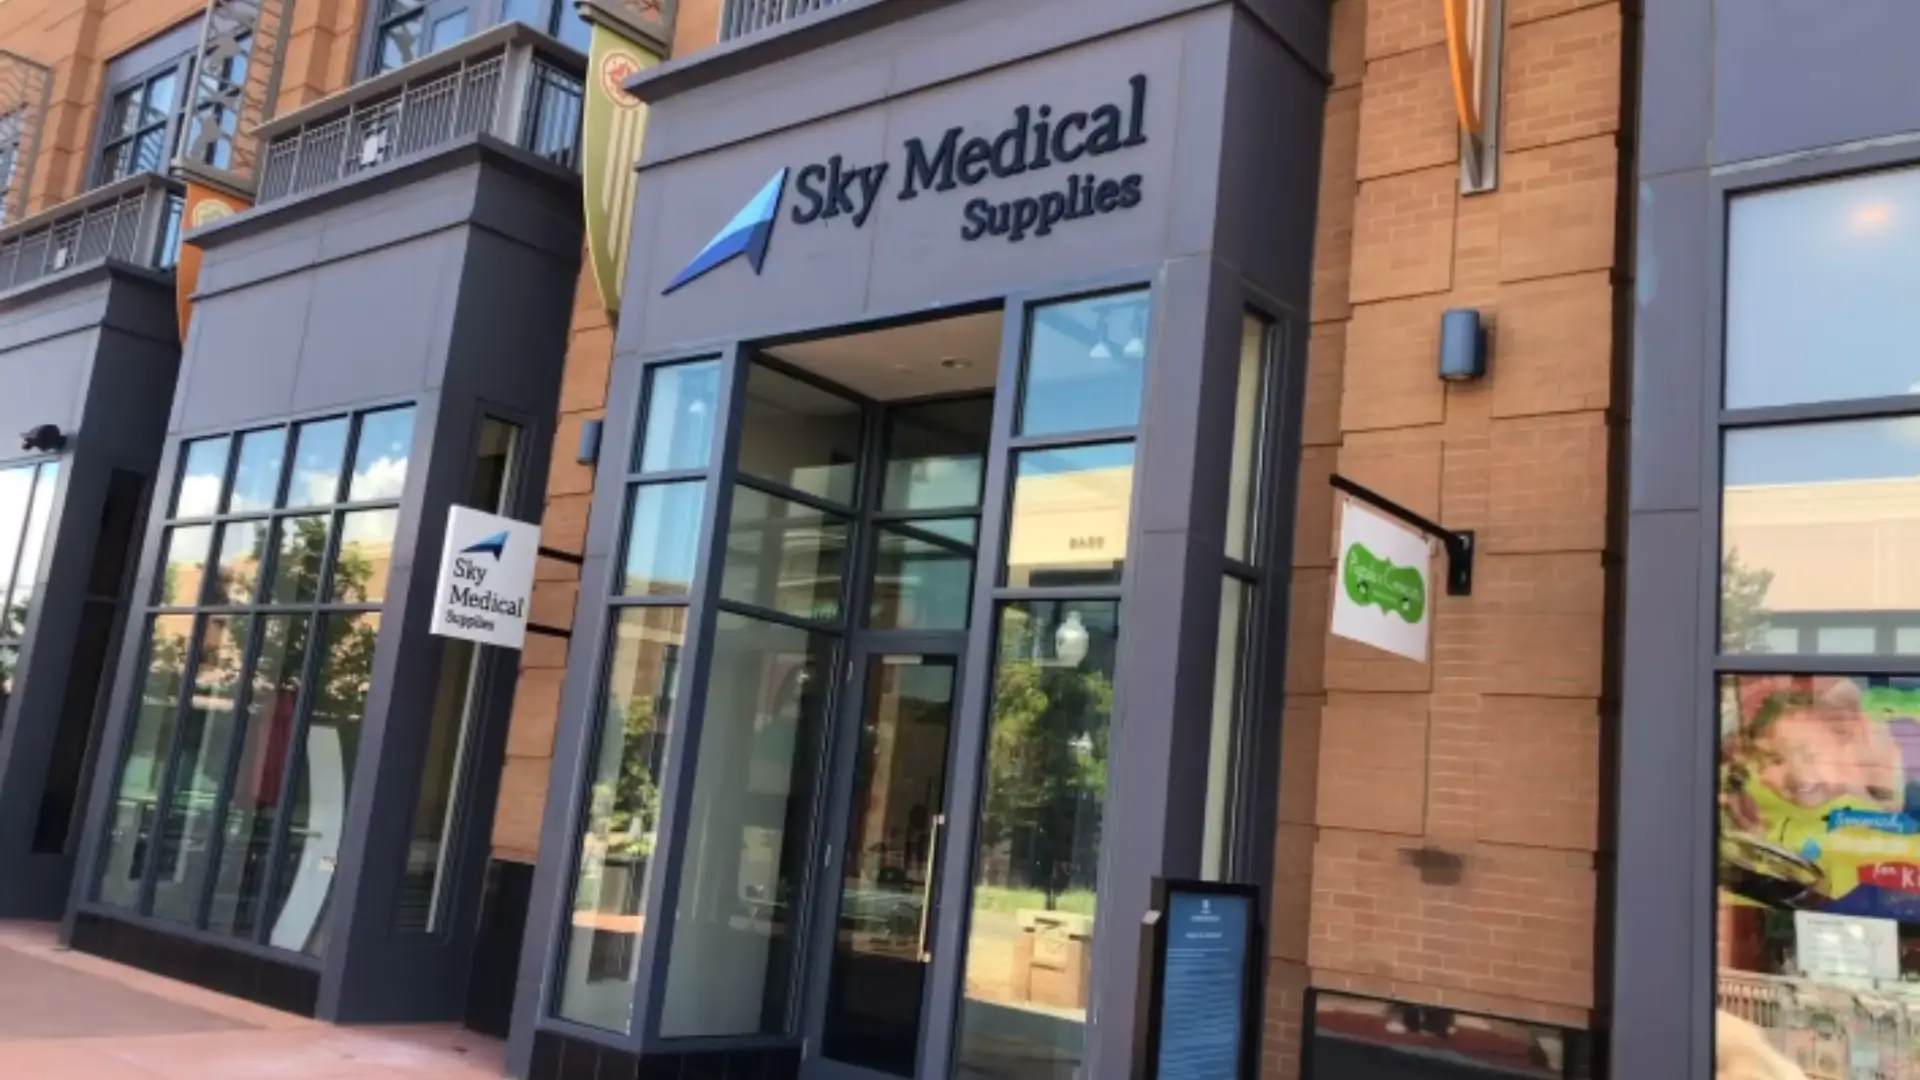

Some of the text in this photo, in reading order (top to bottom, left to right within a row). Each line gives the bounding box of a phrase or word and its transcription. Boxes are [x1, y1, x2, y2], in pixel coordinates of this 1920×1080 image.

[791, 74, 1148, 228] Sky Medical
[961, 173, 1143, 242] Supplies
[453, 557, 487, 586] Sky
[449, 585, 525, 618] Medical
